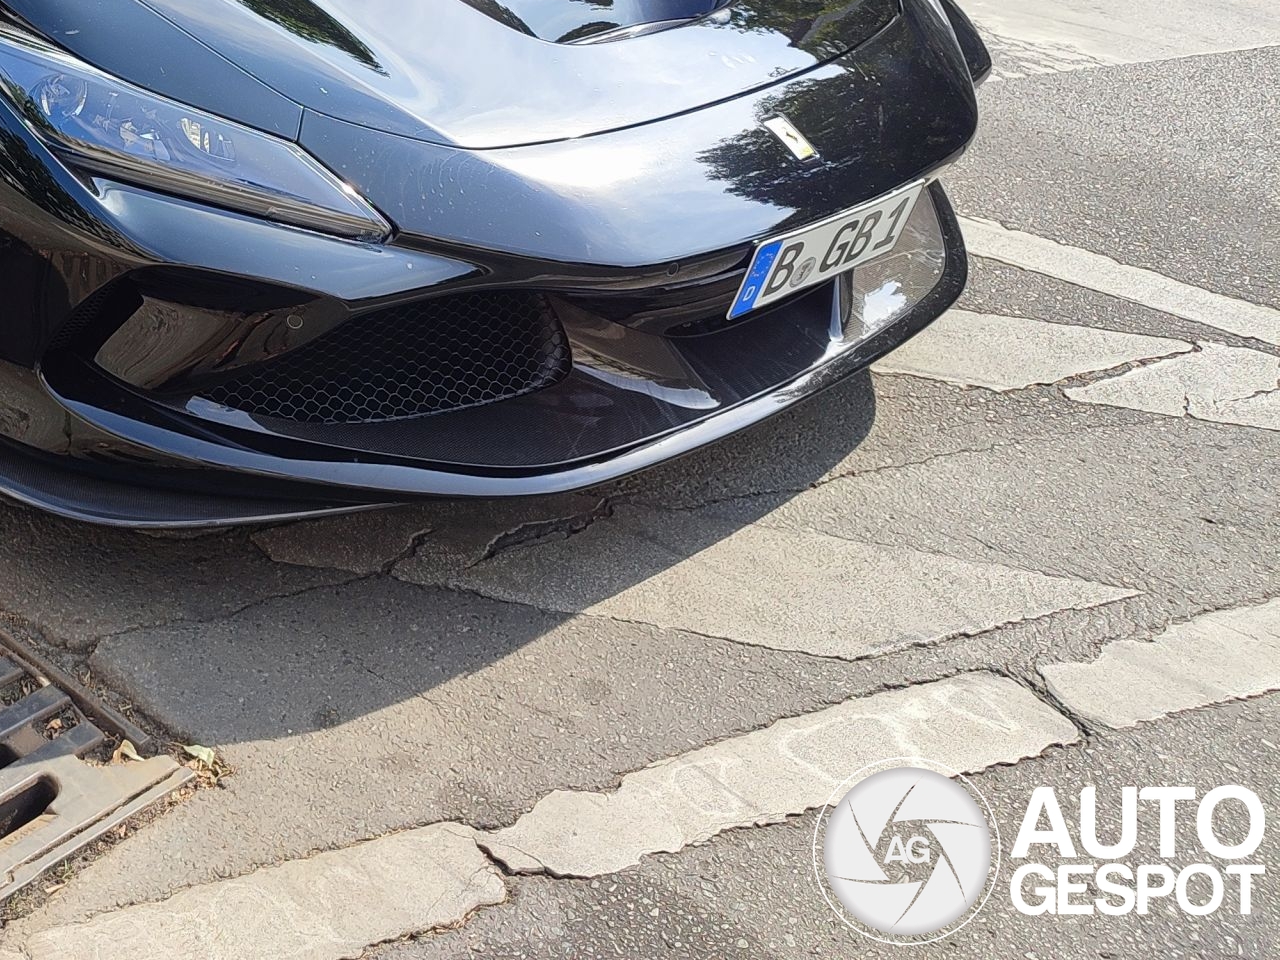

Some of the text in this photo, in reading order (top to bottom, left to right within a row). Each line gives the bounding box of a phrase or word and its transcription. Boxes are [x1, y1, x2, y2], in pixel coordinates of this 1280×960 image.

[770, 197, 910, 291] B GB 1
[743, 285, 756, 301] D
